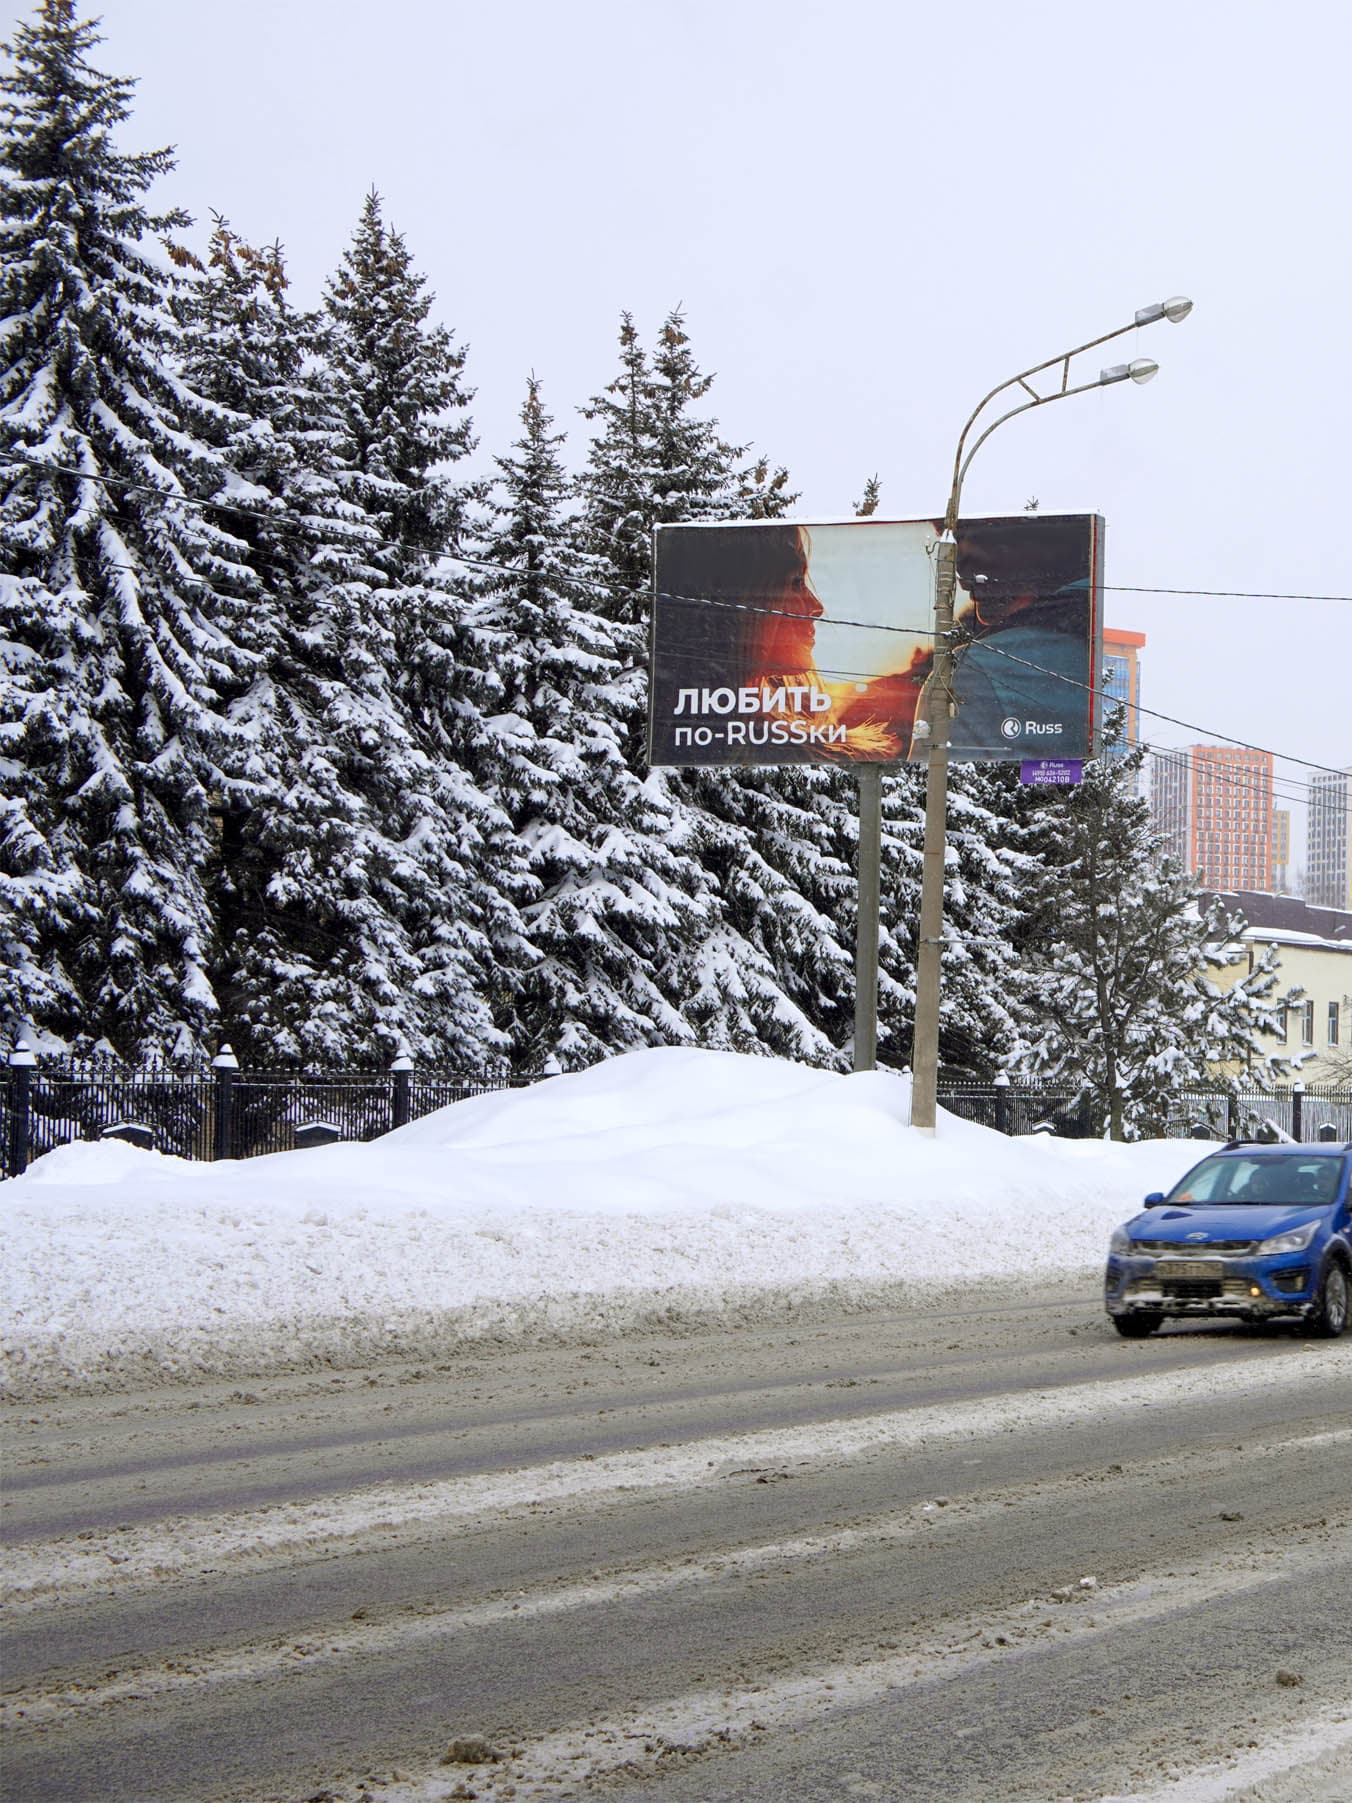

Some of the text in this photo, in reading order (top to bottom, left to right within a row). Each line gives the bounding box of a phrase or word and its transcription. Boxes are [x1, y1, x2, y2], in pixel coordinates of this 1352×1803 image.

[673, 686, 832, 715] ЛЮБИТЬ
[675, 720, 847, 746] по-RUSSки
[1025, 720, 1063, 735] Russ
